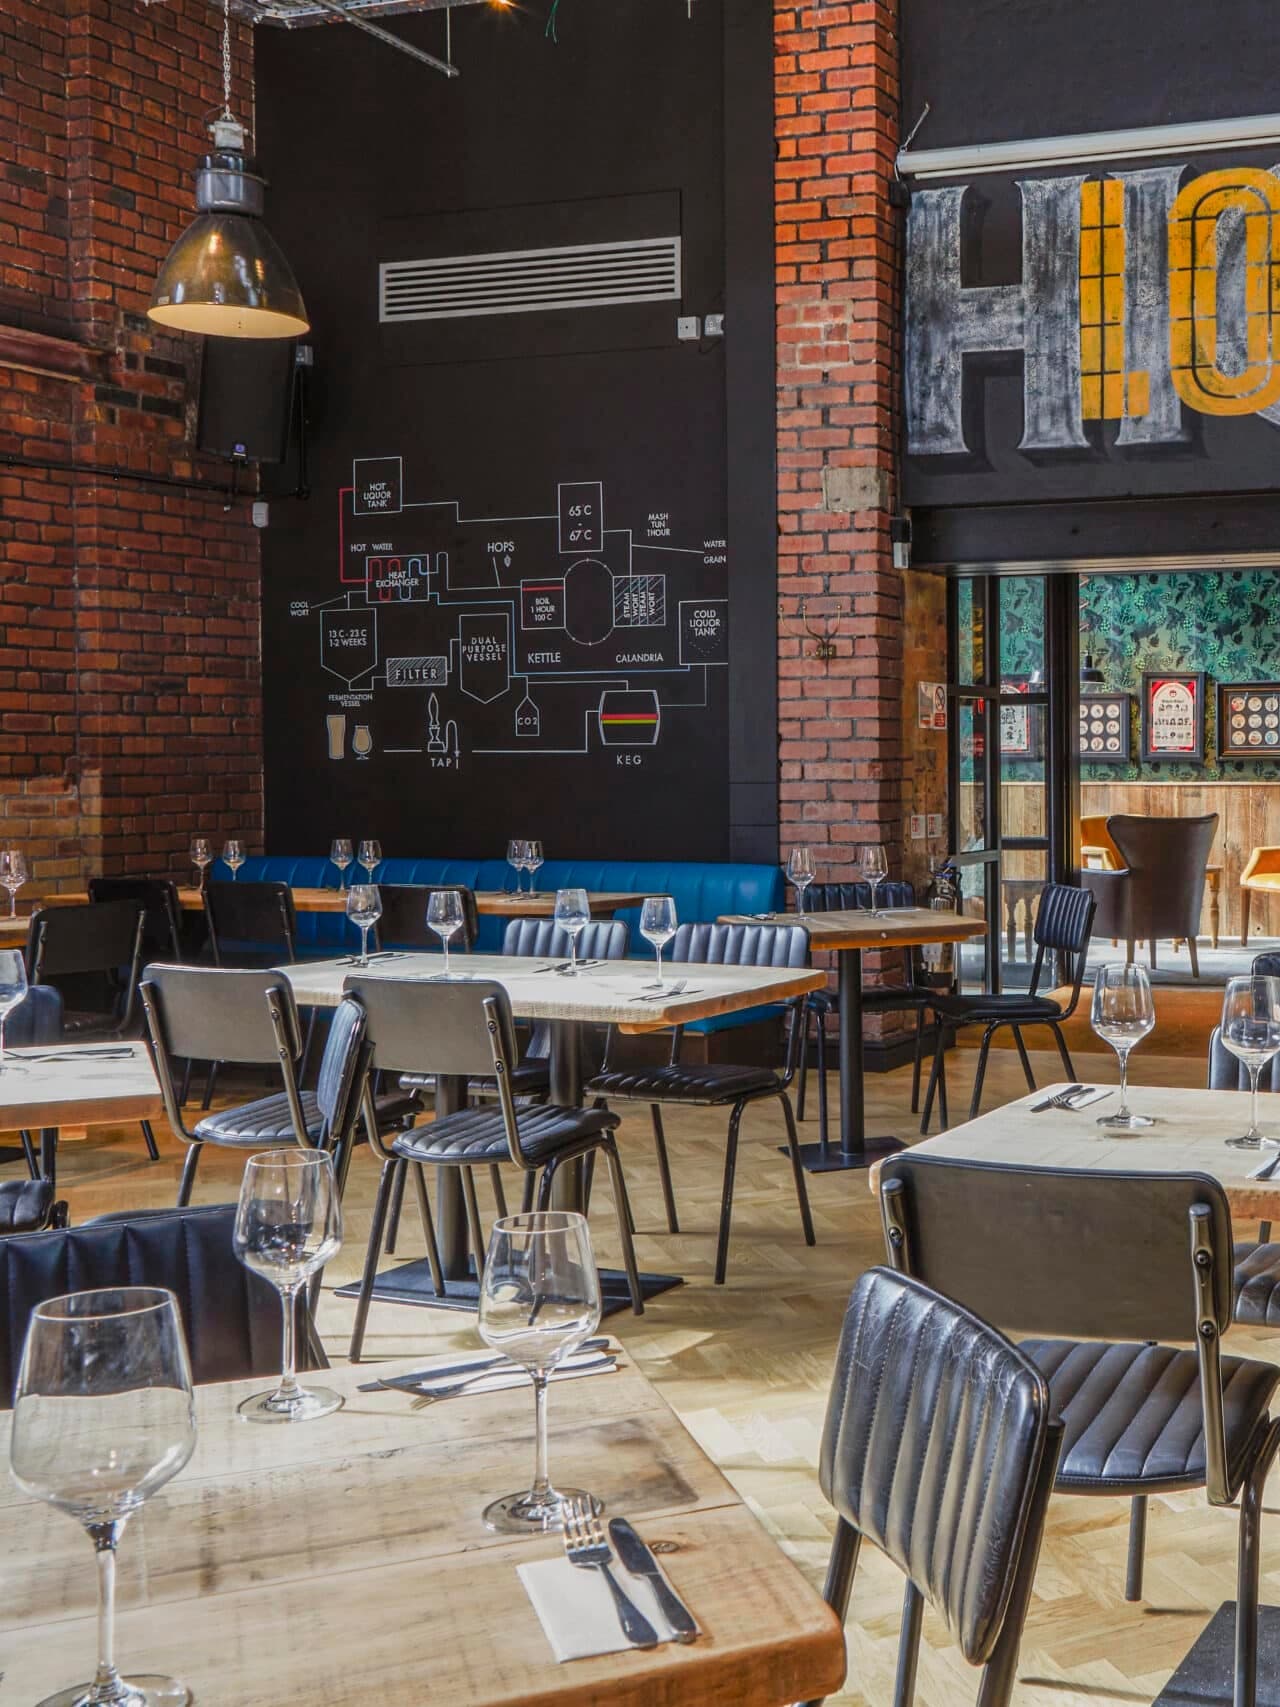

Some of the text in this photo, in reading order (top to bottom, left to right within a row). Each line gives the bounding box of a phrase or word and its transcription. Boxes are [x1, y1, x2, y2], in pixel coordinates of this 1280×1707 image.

[369, 482, 387, 491] HOT
[363, 491, 391, 500] LIQUOR
[368, 499, 388, 508] TANK
[648, 511, 669, 521] MASH
[650, 520, 666, 529] TUN
[350, 542, 393, 553] HOT WATER
[487, 540, 515, 554] HOPS
[703, 540, 727, 549] WATER
[703, 555, 727, 564] GRAIN
[388, 571, 407, 580] HEAT
[375, 578, 420, 588] EXCHANGER
[290, 601, 309, 609] COOL
[535, 597, 551, 606] BOIL
[623, 592, 631, 618] STEAM
[290, 609, 310, 617] WORT
[535, 605, 555, 614] HOUR
[694, 609, 717, 619] COLD
[689, 618, 721, 629] LIQUOR
[694, 627, 717, 637] TANK
[341, 637, 367, 647] WEEKS
[471, 636, 497, 645] DUAL
[462, 644, 507, 654] PURPOSE
[466, 652, 502, 662] VESSEL
[527, 652, 561, 664] KETTLE
[615, 652, 664, 664] CALANDRIA
[395, 668, 438, 680] FILTER
[328, 693, 373, 702] FERMENTATION
[340, 700, 361, 708] VESSEL
[517, 716, 538, 726] CO2
[430, 757, 452, 768] TAP
[616, 755, 642, 765] KEG
